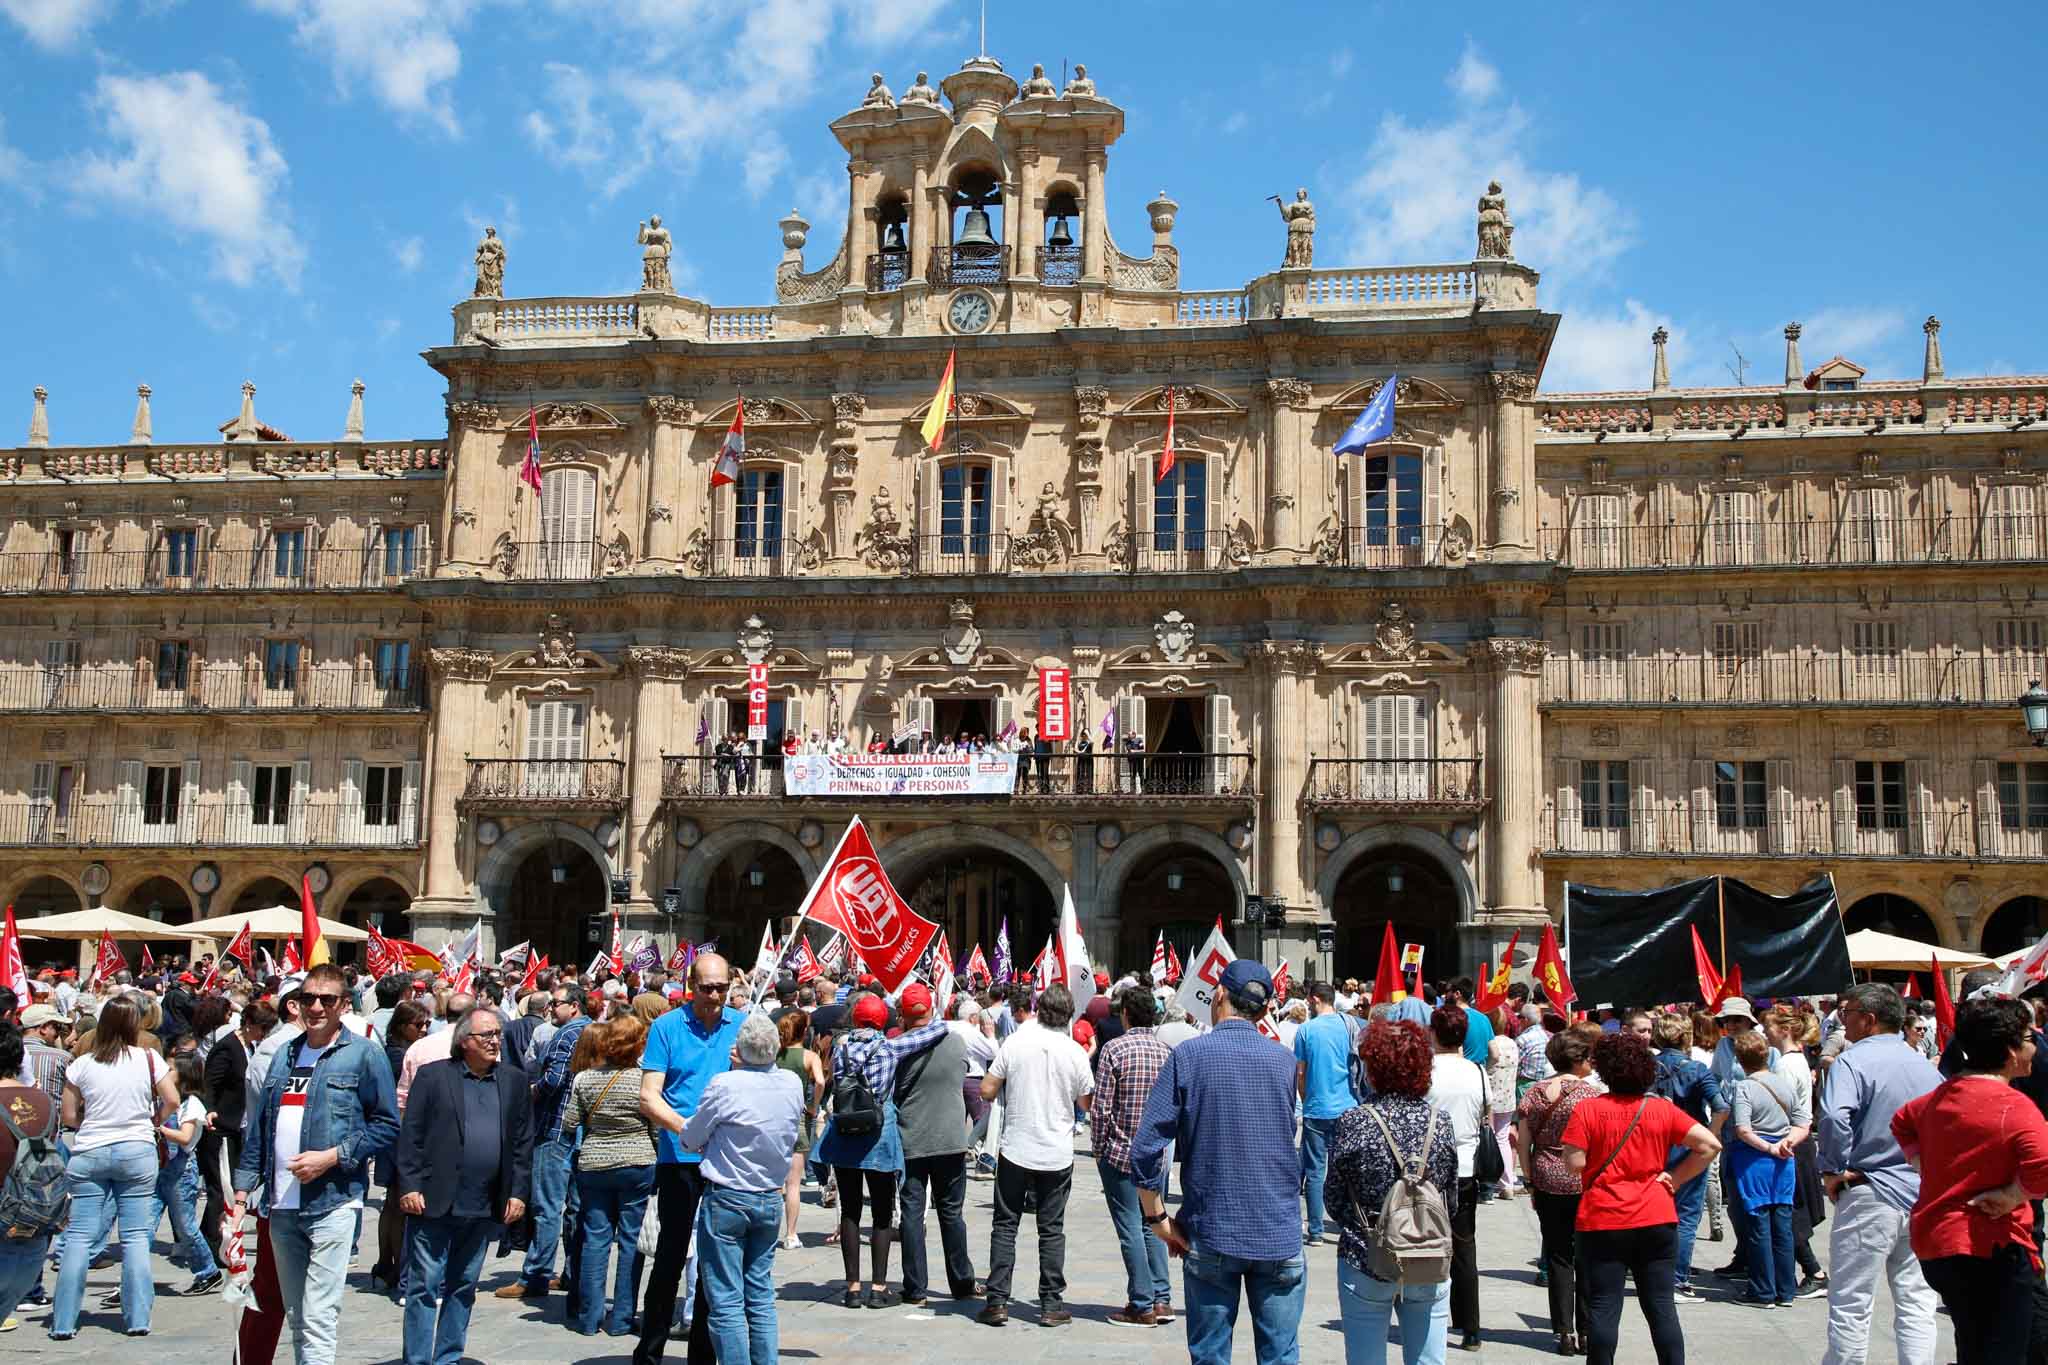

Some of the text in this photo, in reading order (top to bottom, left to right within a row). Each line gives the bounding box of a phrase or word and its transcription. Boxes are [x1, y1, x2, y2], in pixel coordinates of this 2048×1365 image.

[750, 668, 767, 724] UGT
[1045, 670, 1064, 737] CCOO
[852, 754, 896, 764] LUCHA
[837, 767, 876, 778] DERECHOS
[885, 767, 923, 778] IGUALDAD
[829, 779, 970, 793] PRIMERO LAS PERSONAS
[840, 863, 899, 931] UGT
[284, 1078, 308, 1093] ev
